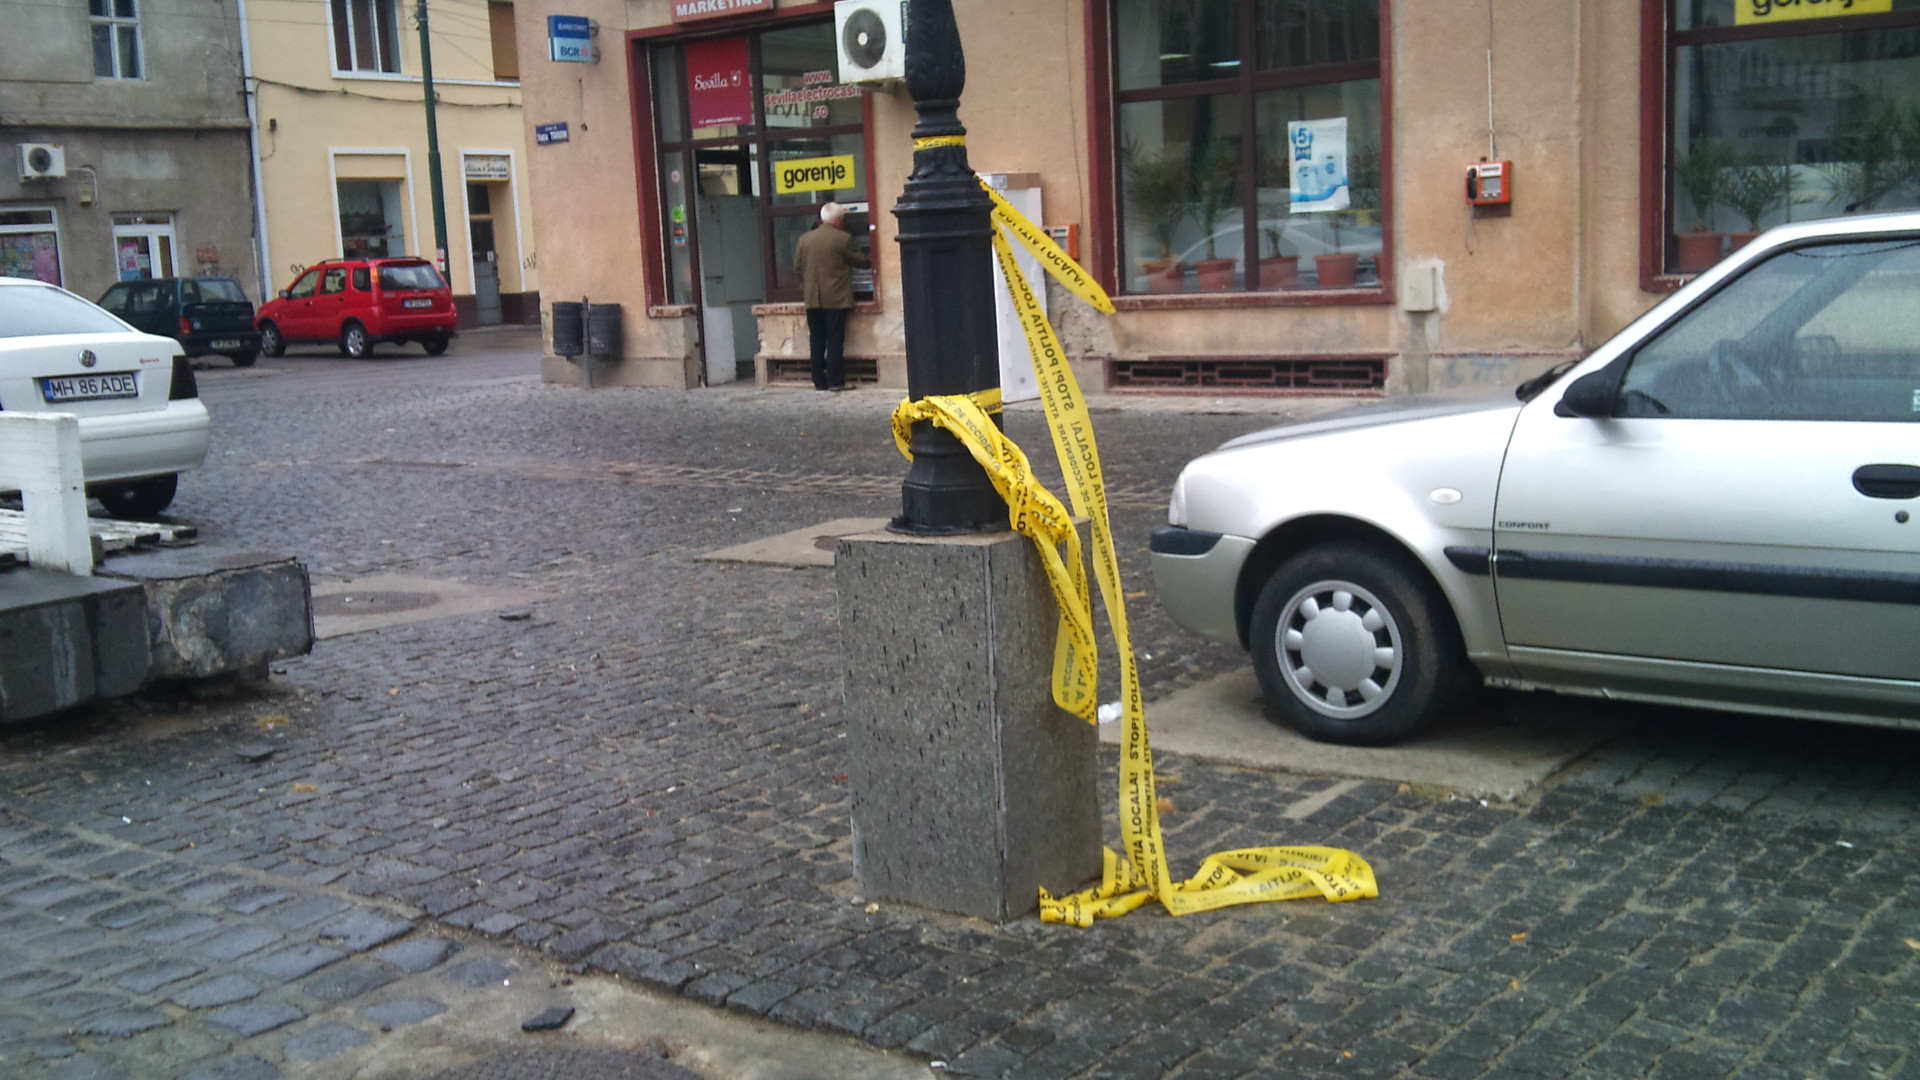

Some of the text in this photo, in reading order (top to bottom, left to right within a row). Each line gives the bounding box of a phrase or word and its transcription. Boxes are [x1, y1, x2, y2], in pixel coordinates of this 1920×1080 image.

[561, 46, 580, 56] BCR
[695, 72, 728, 90] Sevilla
[803, 70, 833, 84] www.
[1298, 127, 1307, 144] 5
[784, 160, 846, 189] gorenje
[51, 376, 134, 396] MH 86 ADE
[1498, 520, 1551, 530] CONFORT
[1129, 717, 1140, 761] STOP!
[1129, 772, 1143, 835] LOCALA!
